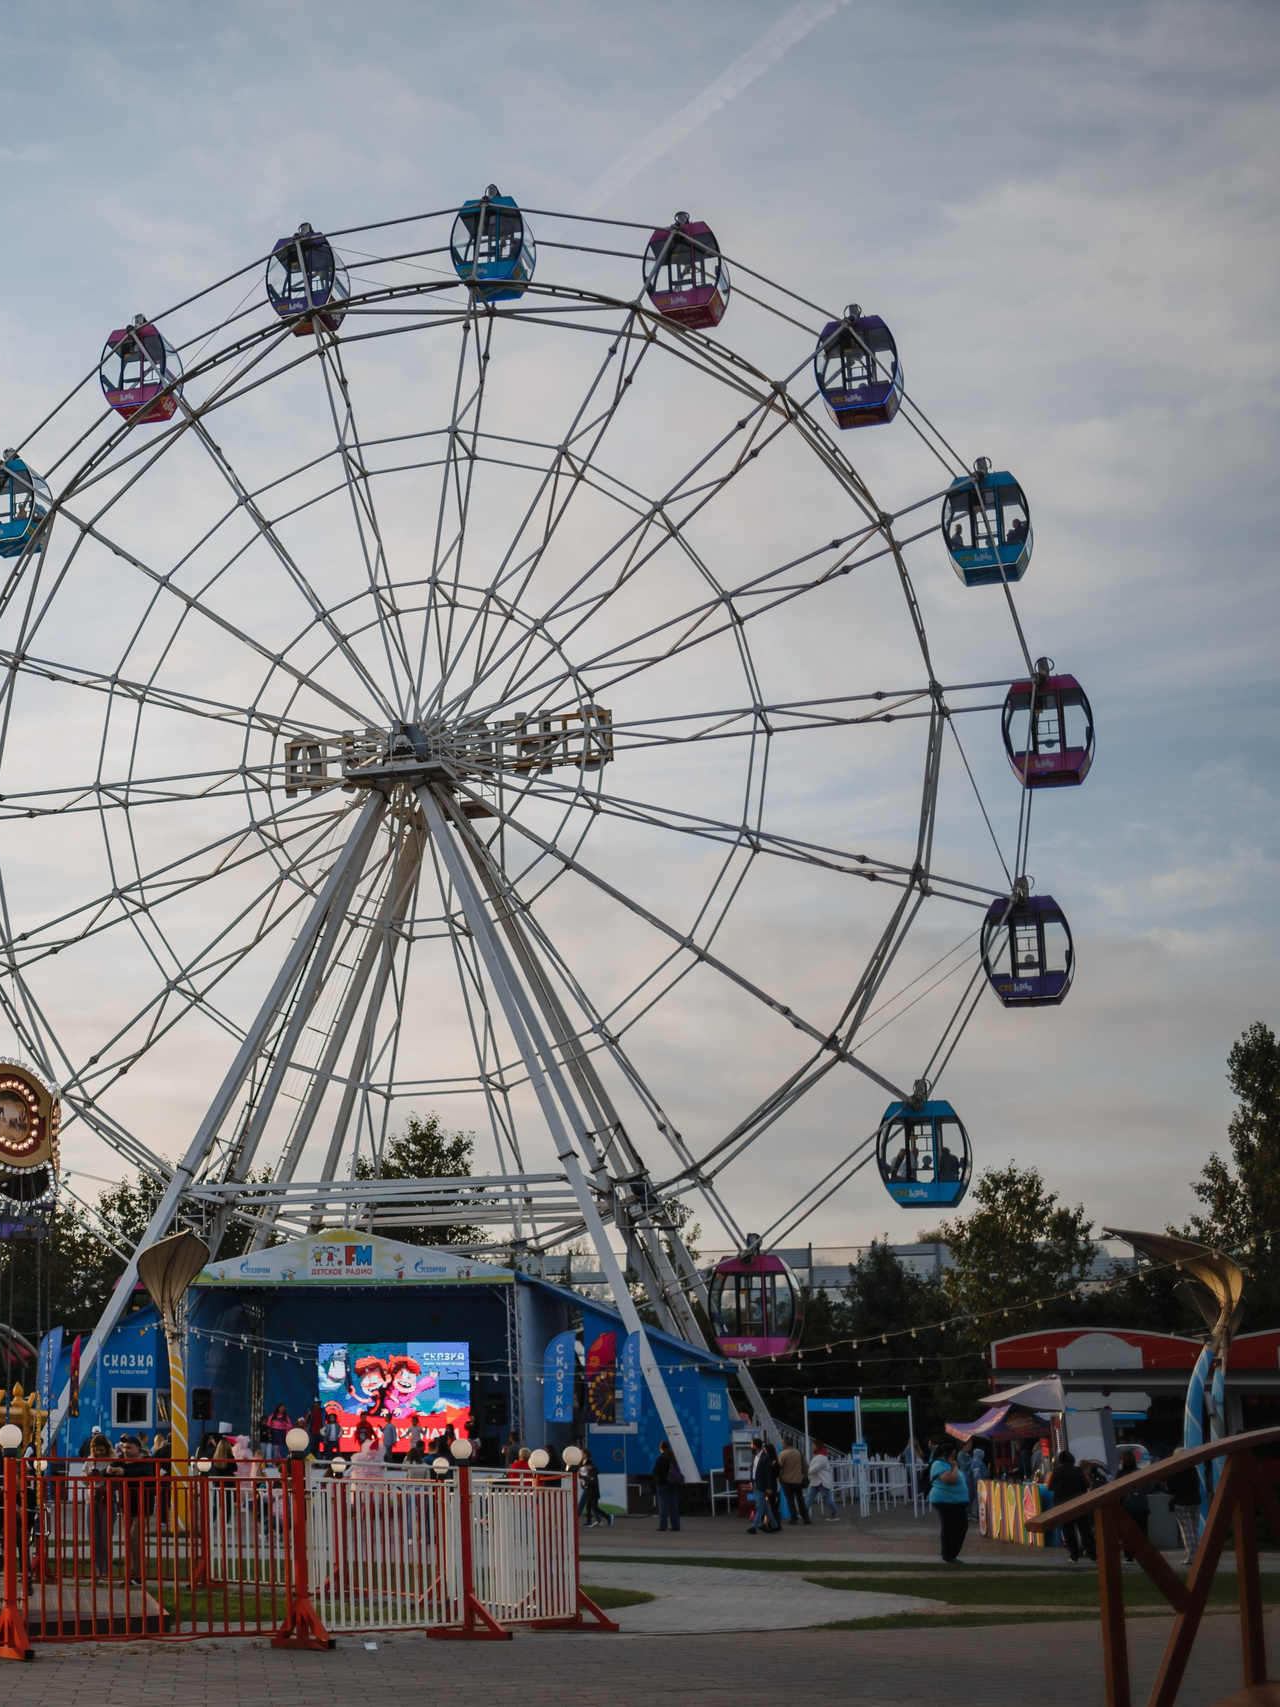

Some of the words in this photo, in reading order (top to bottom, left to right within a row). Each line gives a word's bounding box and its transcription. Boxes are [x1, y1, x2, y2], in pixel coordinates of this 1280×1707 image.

[311, 1268, 342, 1276] ДЕТСКОЕ
[103, 1354, 154, 1367] СКАЗКА
[555, 1343, 565, 1418] СКАЗКА
[628, 1343, 637, 1418] СКАЗКА
